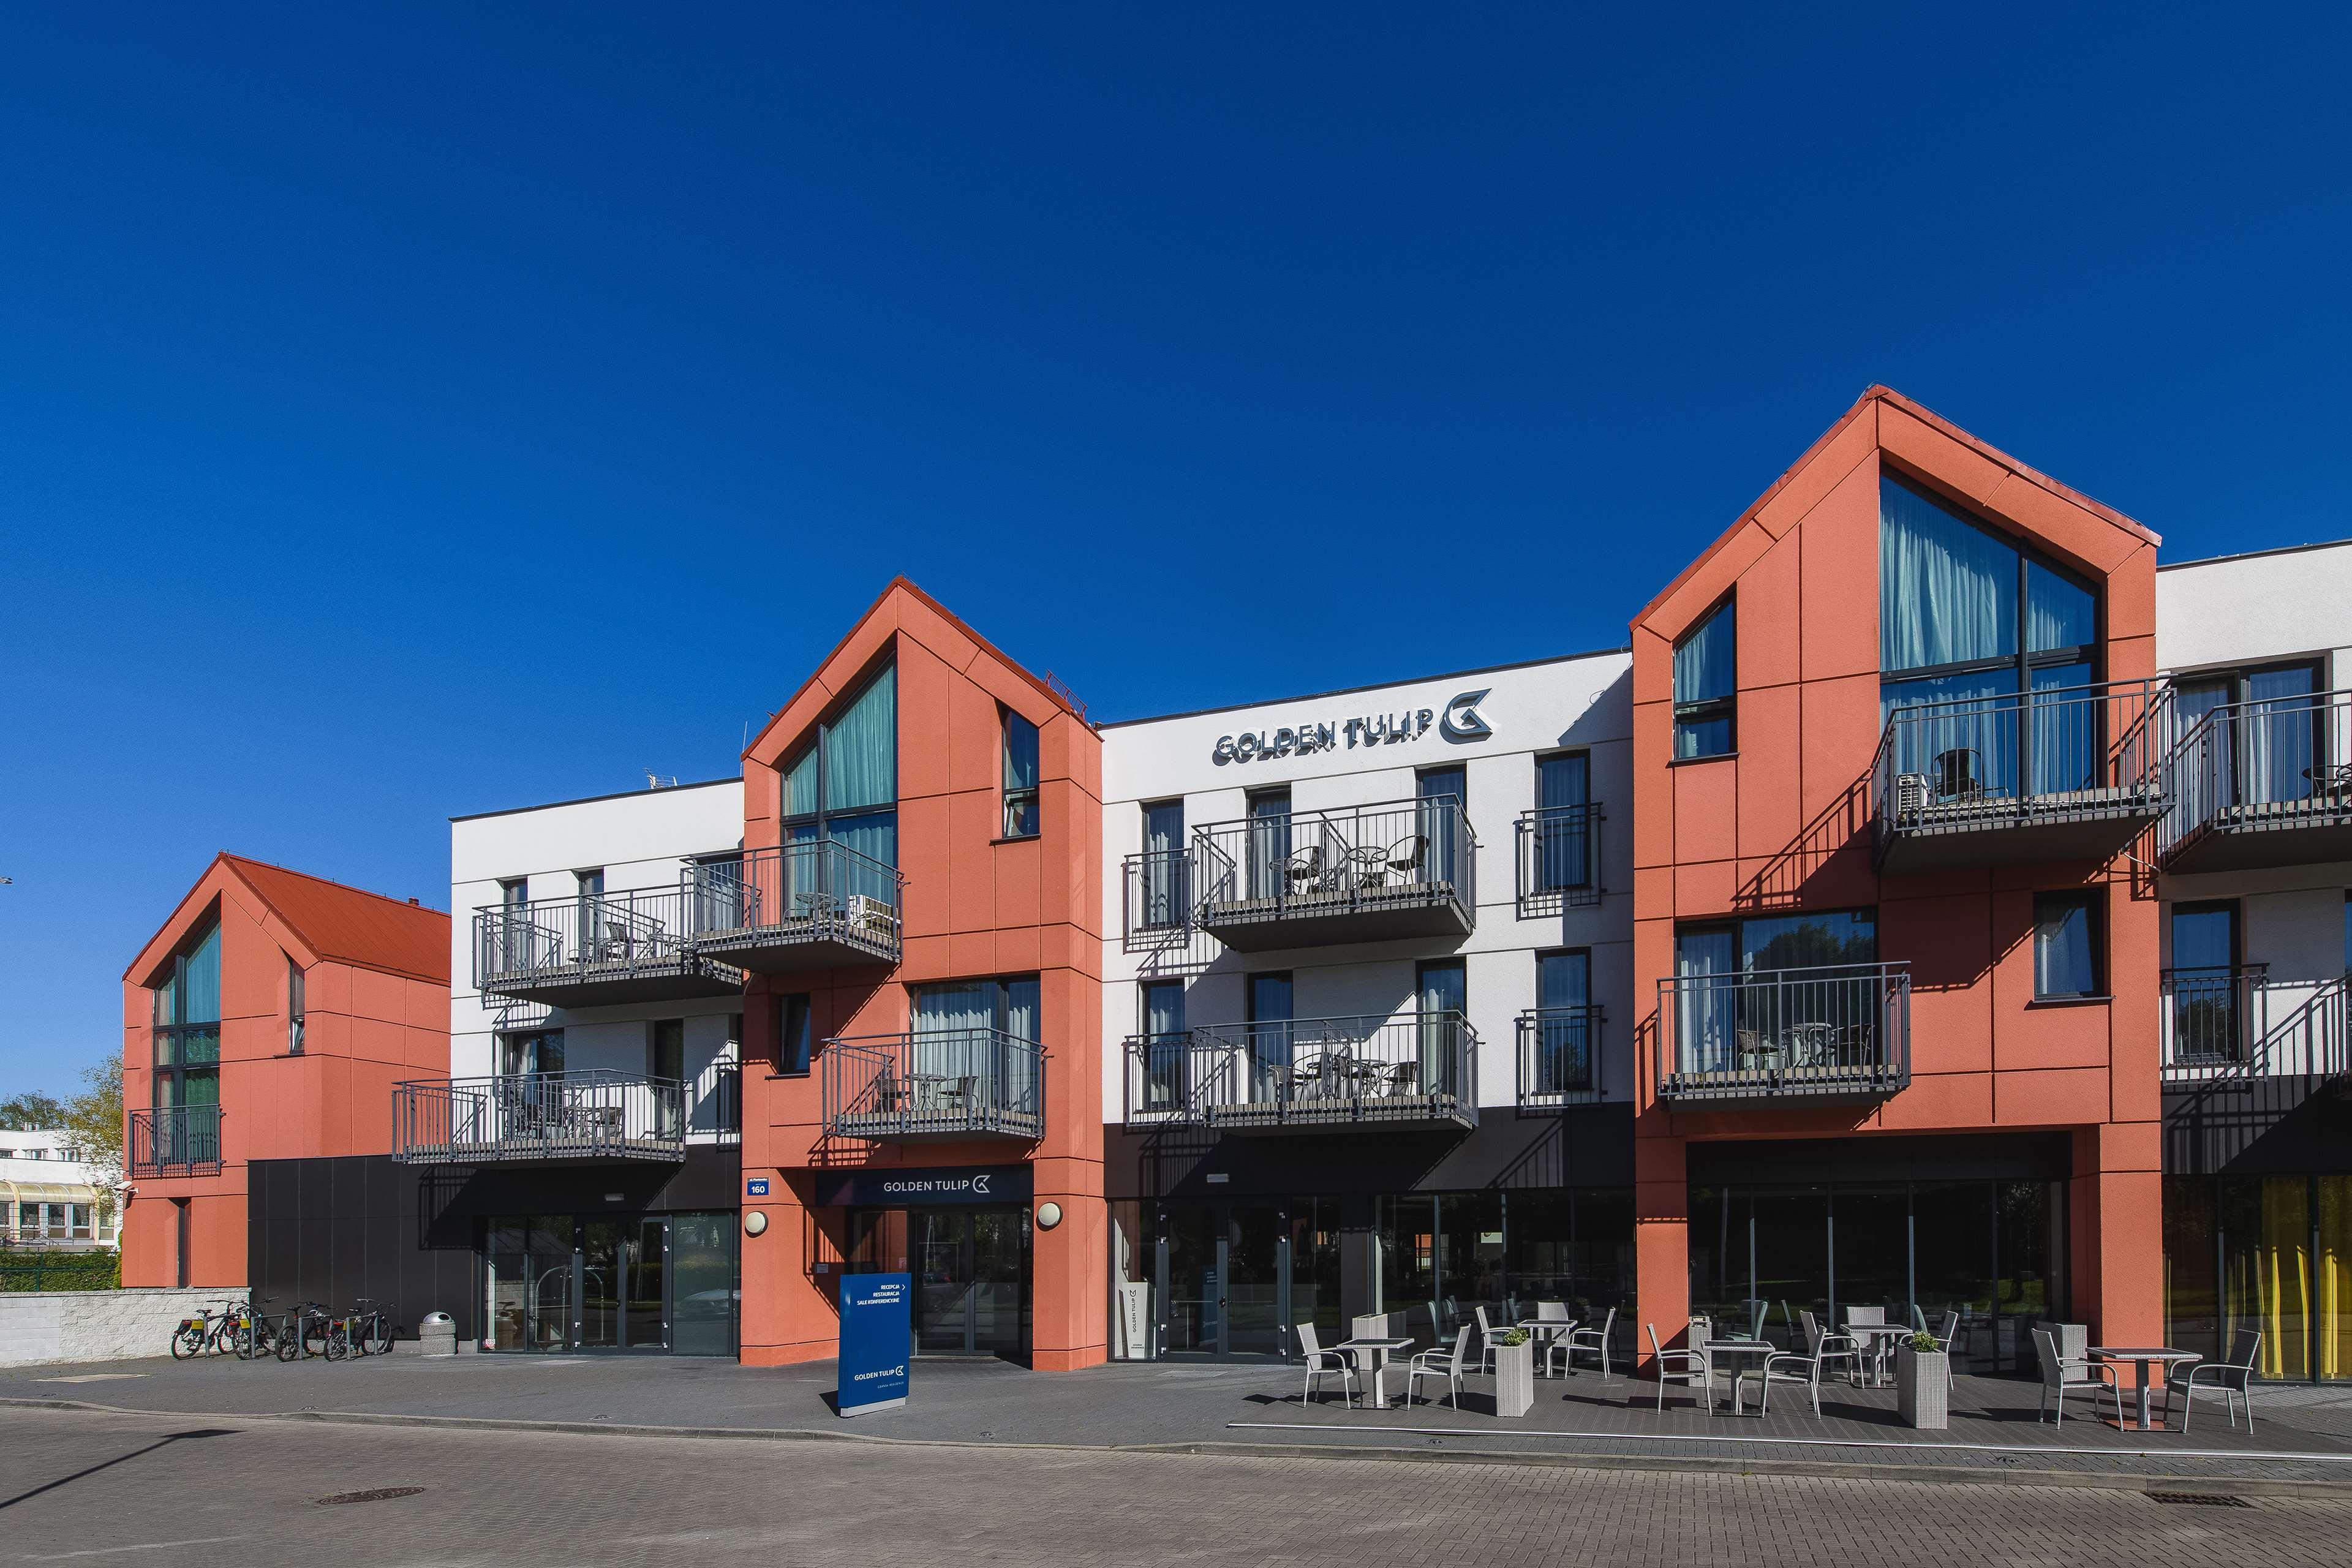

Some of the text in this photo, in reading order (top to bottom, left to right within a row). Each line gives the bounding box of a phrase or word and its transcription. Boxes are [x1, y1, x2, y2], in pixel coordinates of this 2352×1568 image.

[1215, 708, 1434, 757] GOLDEN TULIP
[883, 1180, 970, 1192] GOLDEN TULIP
[854, 1371, 878, 1381] GOLDEN
